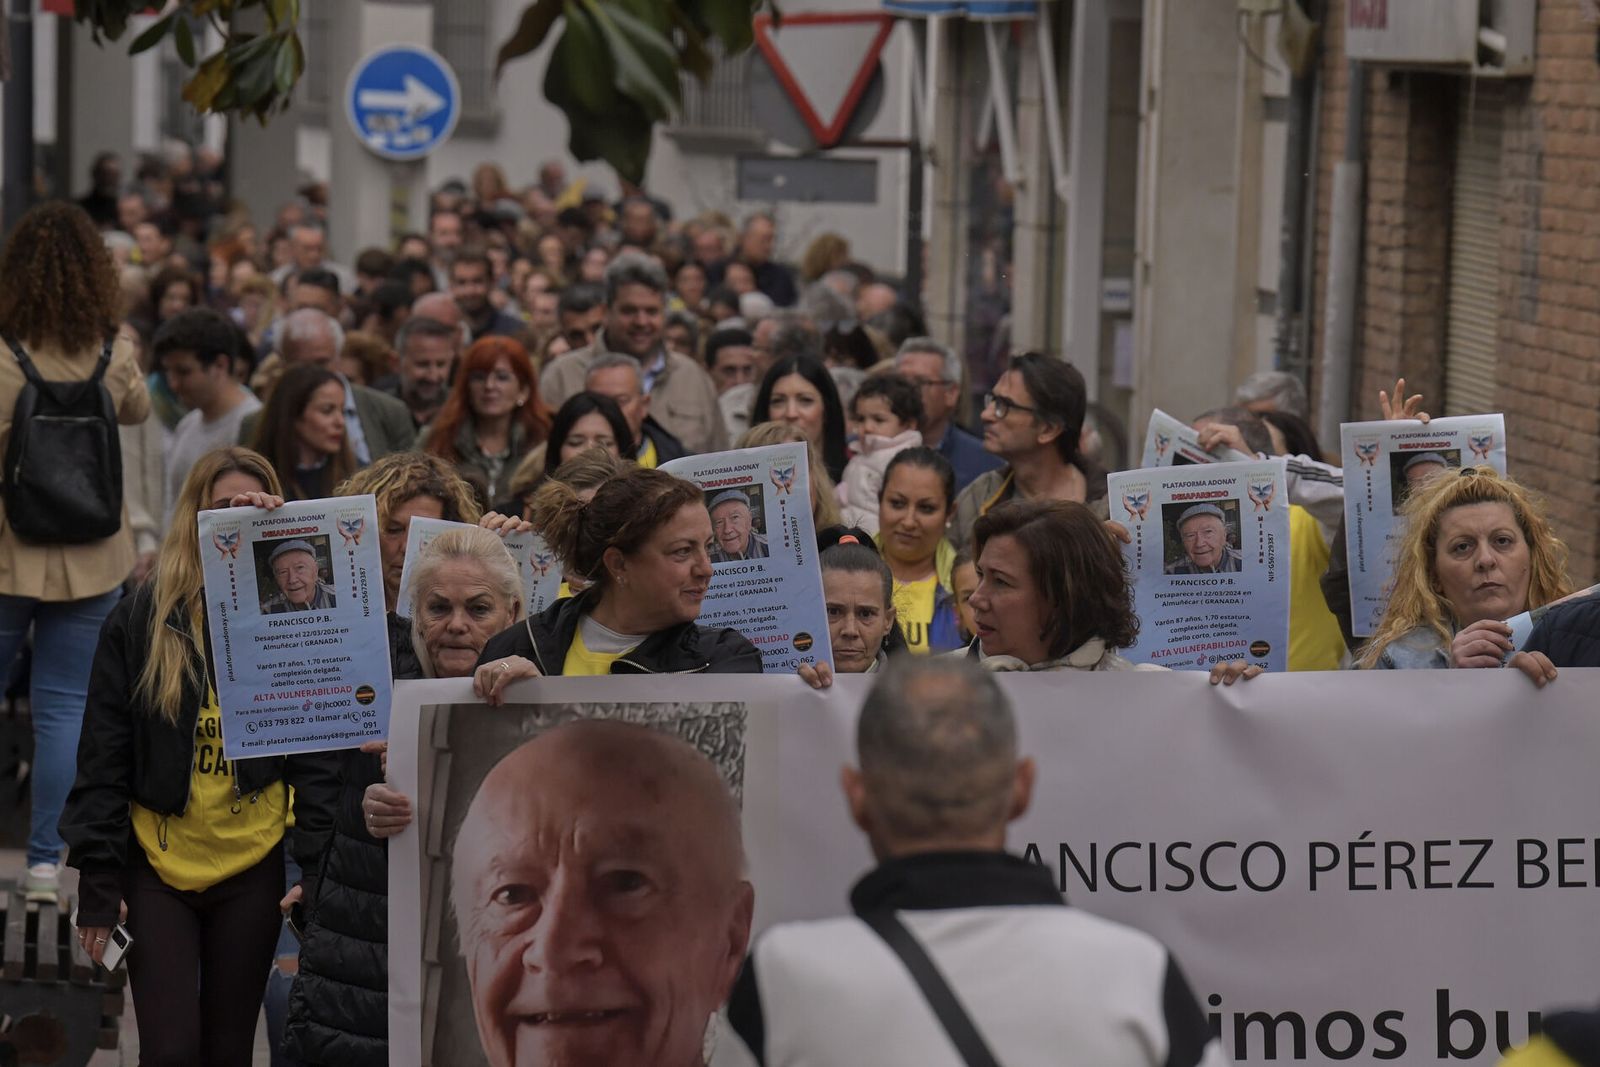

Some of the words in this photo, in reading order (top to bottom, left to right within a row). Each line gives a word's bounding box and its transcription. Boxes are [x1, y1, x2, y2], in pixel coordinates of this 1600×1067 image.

[693, 466, 732, 477] PLATAFORMA
[734, 463, 759, 472] ADONAY
[701, 475, 753, 489] DESAPARECIDO
[1162, 481, 1206, 489] PLATAFORMA
[1208, 478, 1237, 486] ADONAY
[1172, 491, 1228, 500] DESAPARECIDO
[252, 516, 296, 527] PLATAFORMA
[297, 514, 326, 522] ADONAY
[262, 526, 318, 538] DESAPARECIDO
[736, 578, 773, 588] 22/03/2024
[739, 588, 773, 596] GRANADA
[1155, 591, 1194, 599] Desaparece
[1162, 598, 1199, 607] Almuñécar
[758, 605, 788, 613] estatura,
[268, 616, 314, 628] FRANCISCO
[749, 616, 778, 625] delgada,
[1155, 619, 1174, 627] Varón
[1170, 623, 1208, 634] complexión
[1210, 622, 1239, 631] delgada,
[255, 632, 293, 642] Desaparece
[302, 628, 339, 638] 22/03/2024
[1168, 635, 1190, 644] cabello
[263, 641, 299, 651] Almuñécar
[305, 638, 338, 647] GRANADA
[1151, 650, 1173, 659] ALTA
[1174, 640, 1247, 655] VULNERABILIDAD
[256, 661, 277, 670] Varón
[288, 660, 305, 668] años,
[307, 658, 321, 666] 1,70
[322, 656, 352, 664] estatura,
[1209, 653, 1245, 664] @jhc0002
[273, 669, 312, 679] complexión
[314, 666, 342, 675] delgada,
[271, 680, 296, 688] cabello
[296, 678, 316, 686] corto,
[317, 675, 343, 684] canoso.
[254, 693, 276, 702] ALTA
[277, 686, 353, 700] VULNERABILIDAD
[263, 705, 299, 714] información
[314, 700, 351, 710] @jhc0002
[259, 719, 273, 728] 633
[274, 718, 289, 726] 793
[290, 716, 305, 725] 822
[315, 714, 341, 723] llamar
[362, 710, 376, 718] 062
[364, 721, 377, 729] 091
[242, 739, 266, 747] E-mail:
[267, 729, 381, 746] plataformaadonay68@gmail.com
[1308, 830, 1495, 892] PÉREZ
[1516, 838, 1600, 888] BE
